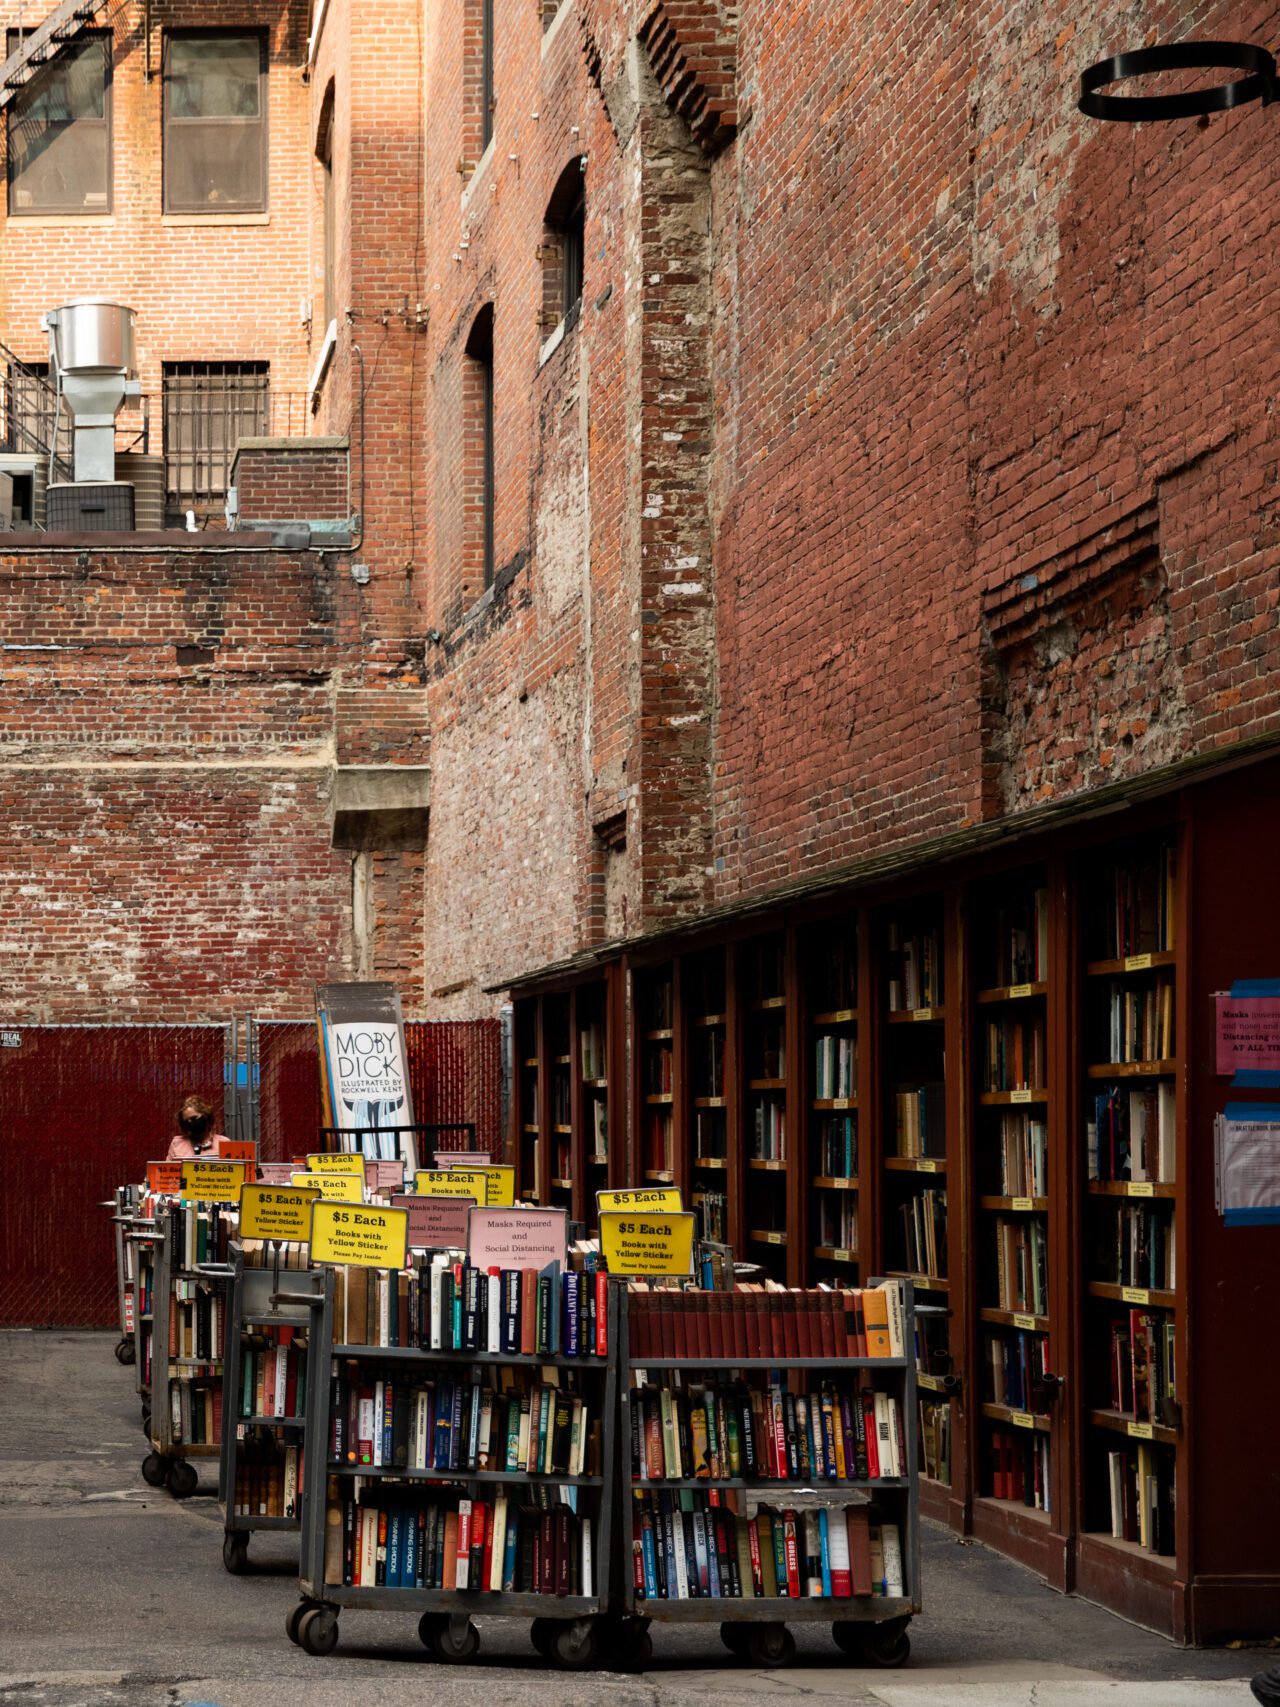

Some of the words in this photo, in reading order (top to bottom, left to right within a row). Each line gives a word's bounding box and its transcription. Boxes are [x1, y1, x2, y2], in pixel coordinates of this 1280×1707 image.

[1, 1032, 20, 1040] IDEAL
[1223, 1033, 1269, 1042] Distancing
[336, 1032, 396, 1055] MOBY
[338, 1055, 400, 1078] DICK
[341, 1086, 380, 1094] ROCKWELL
[317, 1156, 329, 1164] $5
[193, 1164, 206, 1172] $5
[210, 1164, 234, 1172] Each
[428, 1173, 443, 1184] $5
[446, 1174, 474, 1184] Each
[307, 1180, 320, 1188] $5
[323, 1180, 347, 1188] Each
[258, 1194, 273, 1204] $5
[276, 1194, 302, 1205] Each
[613, 1193, 630, 1204] $5
[634, 1192, 666, 1203] Each
[408, 1204, 428, 1212] Masks
[430, 1204, 464, 1214] Required
[278, 1218, 304, 1226] Sticker
[332, 1212, 349, 1222] $5
[354, 1214, 386, 1226] Each
[428, 1225, 465, 1234] Distancing
[488, 1220, 508, 1228] Masks
[510, 1220, 552, 1230] Required
[618, 1223, 635, 1234] $5
[640, 1224, 672, 1236] Each
[335, 1230, 360, 1238] Books
[362, 1232, 382, 1240] with
[512, 1232, 528, 1240] and
[328, 1238, 356, 1248] Yellow
[359, 1240, 388, 1250] Sticker
[485, 1244, 509, 1252] Social
[511, 1244, 555, 1254] Distancing
[622, 1240, 646, 1248] Books
[648, 1242, 667, 1250] with
[616, 1250, 642, 1258] Yellow
[644, 1252, 674, 1260] Sticker
[568, 1274, 578, 1288] TOM
[568, 1289, 578, 1314] CLANCY
[879, 1422, 889, 1441] KATAKI
[776, 1422, 786, 1452] GUILTY
[746, 1434, 754, 1465] BULLETS
[696, 1516, 704, 1532] GLENN
[788, 1540, 796, 1570] GODLESS
